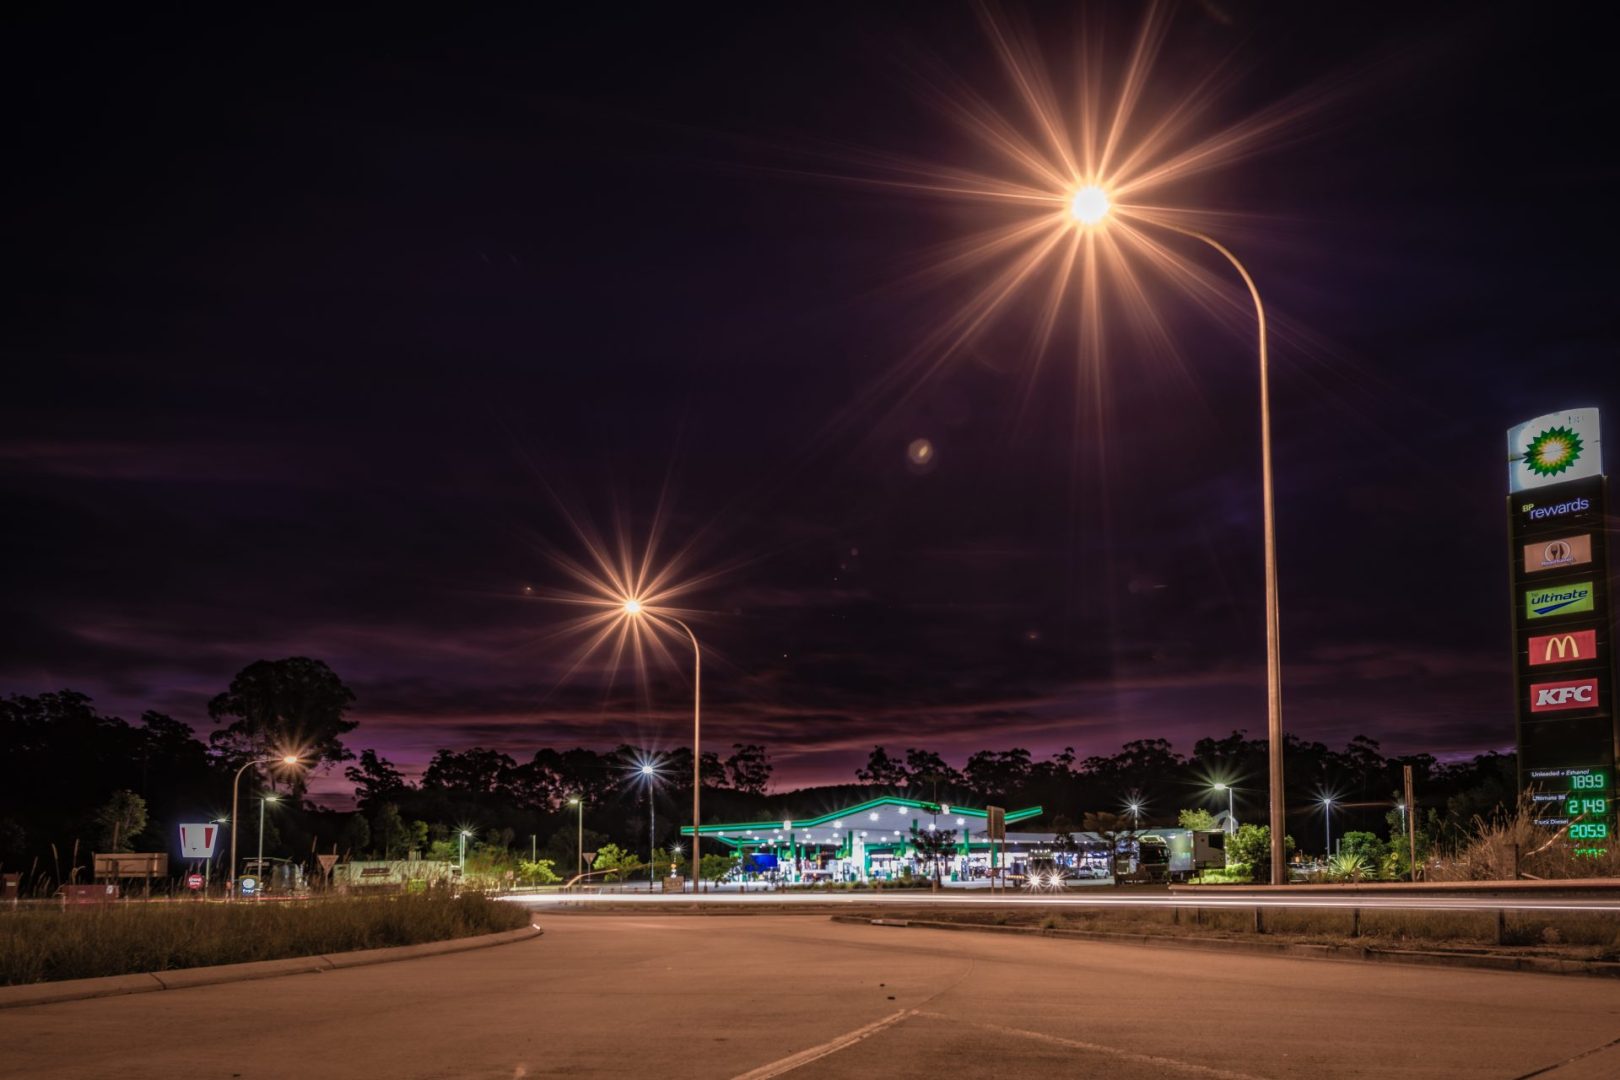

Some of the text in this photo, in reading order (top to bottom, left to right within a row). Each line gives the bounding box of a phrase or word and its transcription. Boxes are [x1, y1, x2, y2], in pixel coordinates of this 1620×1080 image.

[1522, 503, 1534, 512] BP
[1529, 497, 1590, 520] rewards
[1531, 589, 1588, 605] ultimate
[1536, 685, 1593, 707] KFC
